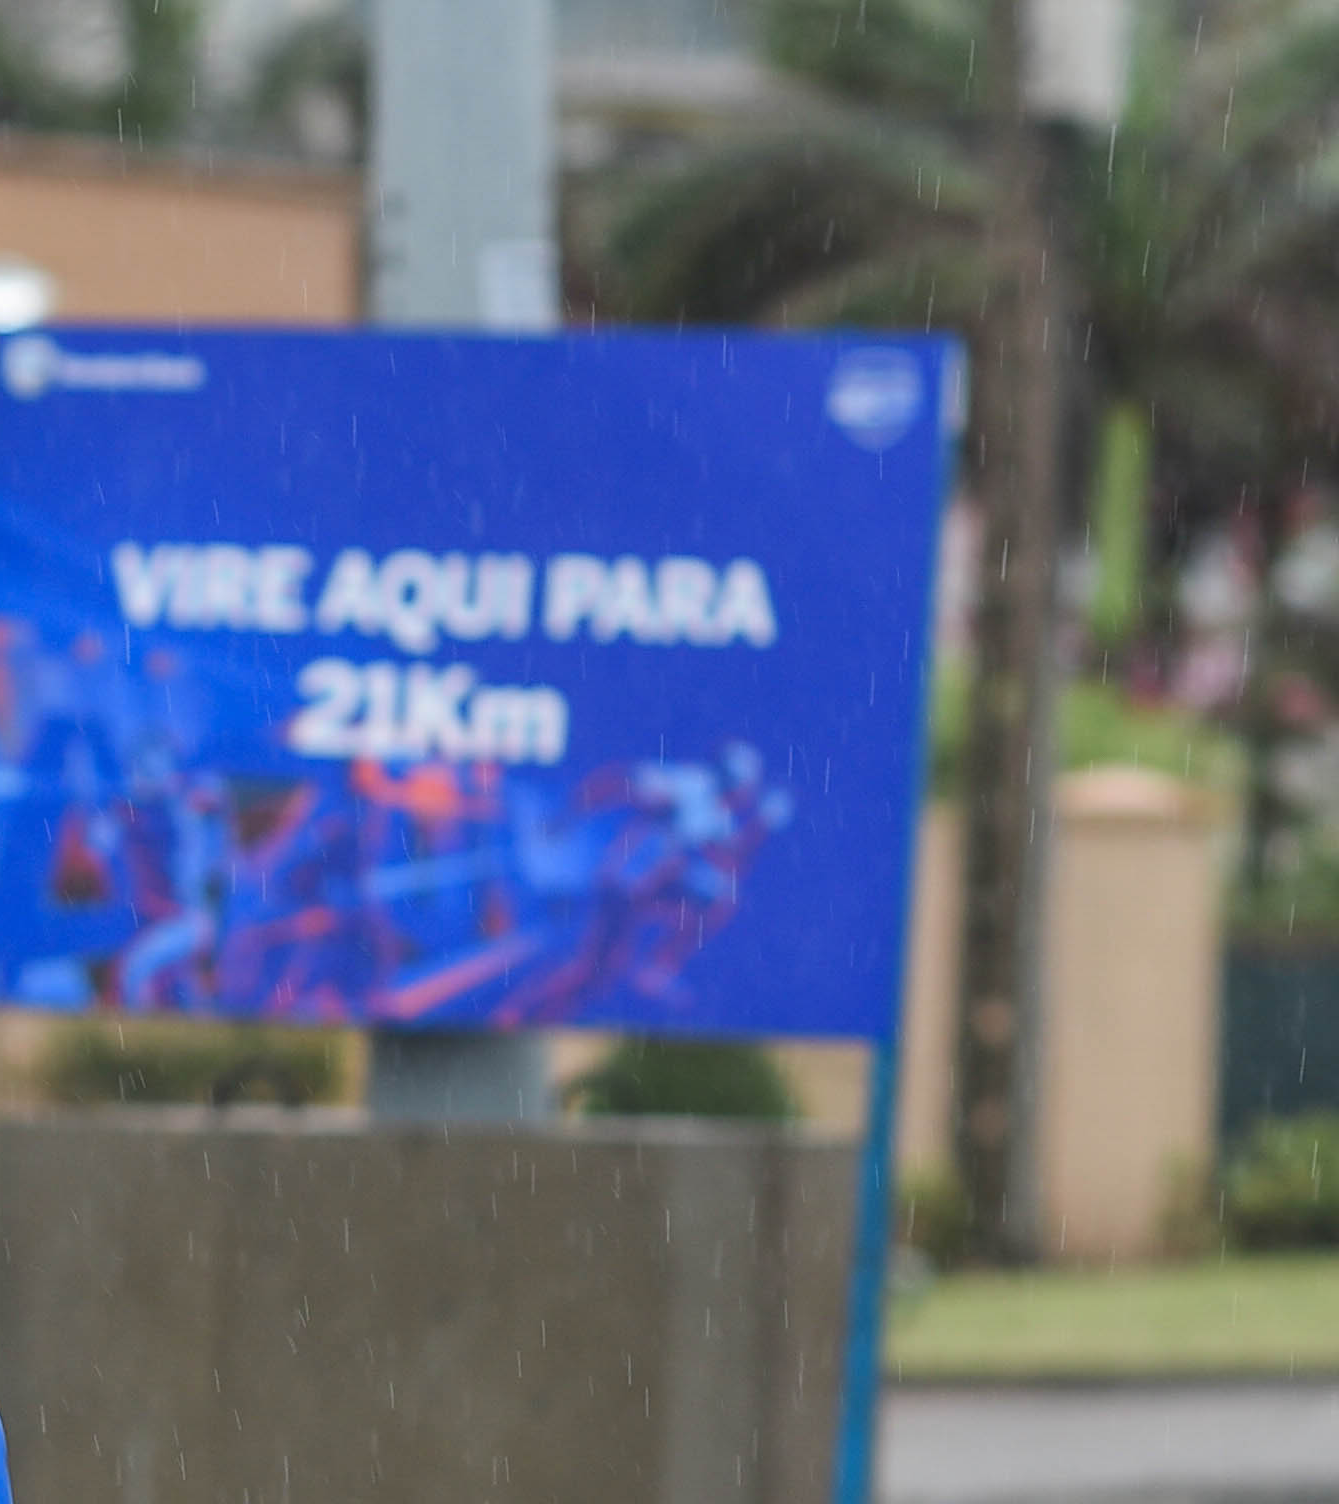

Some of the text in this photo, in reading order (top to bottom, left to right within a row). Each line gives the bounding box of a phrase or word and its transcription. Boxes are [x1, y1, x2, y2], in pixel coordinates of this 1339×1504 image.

[115, 544, 776, 650] VIRE AQUI PARA
[291, 660, 567, 762] 21Km
